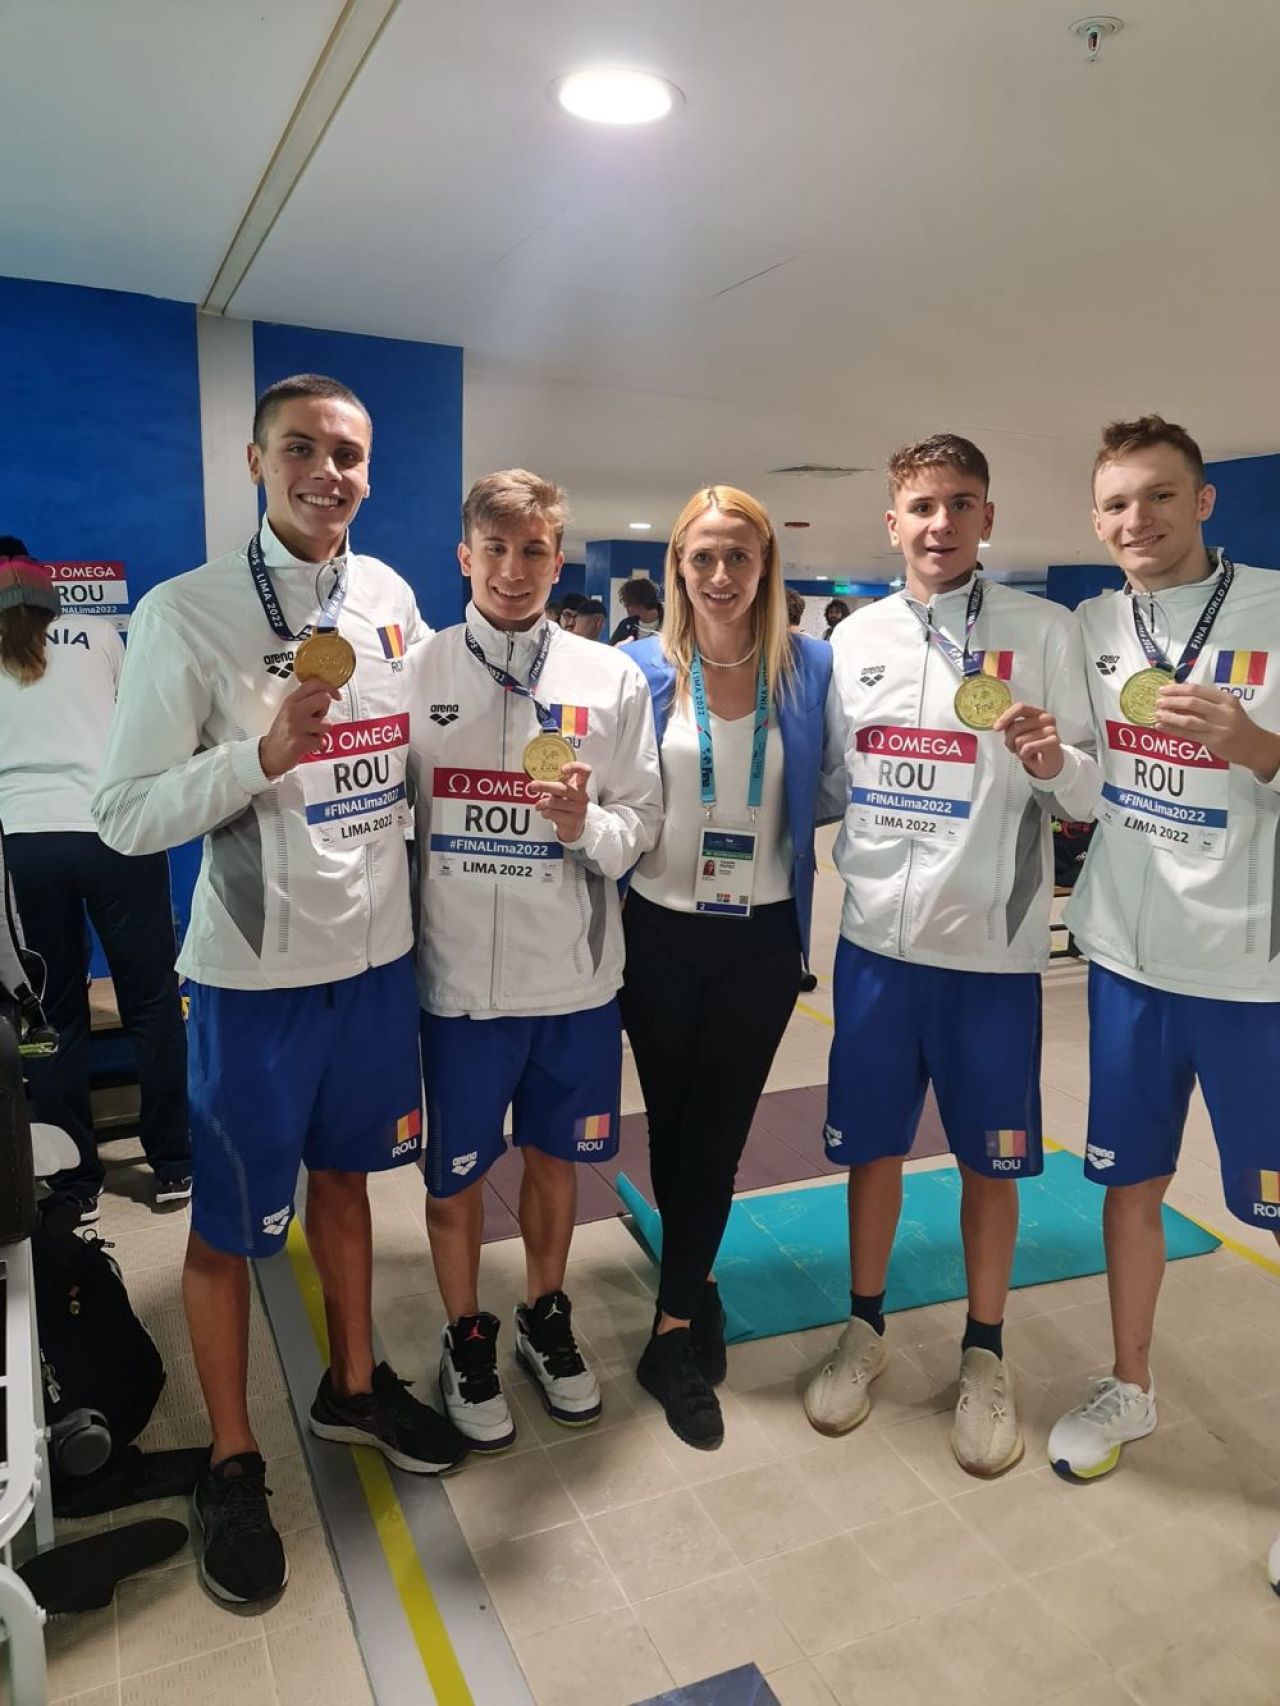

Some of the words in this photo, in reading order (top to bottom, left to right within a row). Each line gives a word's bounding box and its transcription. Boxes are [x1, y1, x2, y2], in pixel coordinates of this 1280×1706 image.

[61, 566, 116, 578] OMEGA
[56, 585, 104, 603] ROU
[257, 573, 272, 601] LIMA
[267, 603, 283, 628] 2022
[61, 606, 117, 614] NALima2022
[1191, 626, 1209, 650] FINA
[1203, 588, 1225, 624] WORLD
[263, 651, 294, 664] arena
[861, 665, 885, 675] arena
[430, 704, 459, 712] arena
[339, 723, 403, 750] OMEGA
[888, 735, 963, 757] OMEGA
[1141, 735, 1214, 762] OMEGA
[333, 754, 389, 794] ROU
[879, 760, 936, 791] ROU
[1134, 758, 1184, 797] ROU
[324, 788, 399, 817] #FINALima2022
[341, 822, 371, 838] LIMA
[373, 814, 392, 831] 2022
[465, 804, 530, 835] ROU
[875, 815, 904, 829] LIMA
[906, 819, 937, 833] 2022
[1124, 817, 1158, 836] LIMA
[1160, 826, 1190, 843] 2022
[450, 839, 549, 856] #FINALima2022
[463, 861, 497, 874] LIMA
[500, 864, 533, 877] 2022
[392, 1138, 417, 1158] ROU
[577, 1140, 604, 1151] ROU
[992, 1160, 1021, 1170] ROU
[263, 1205, 290, 1226] arena
